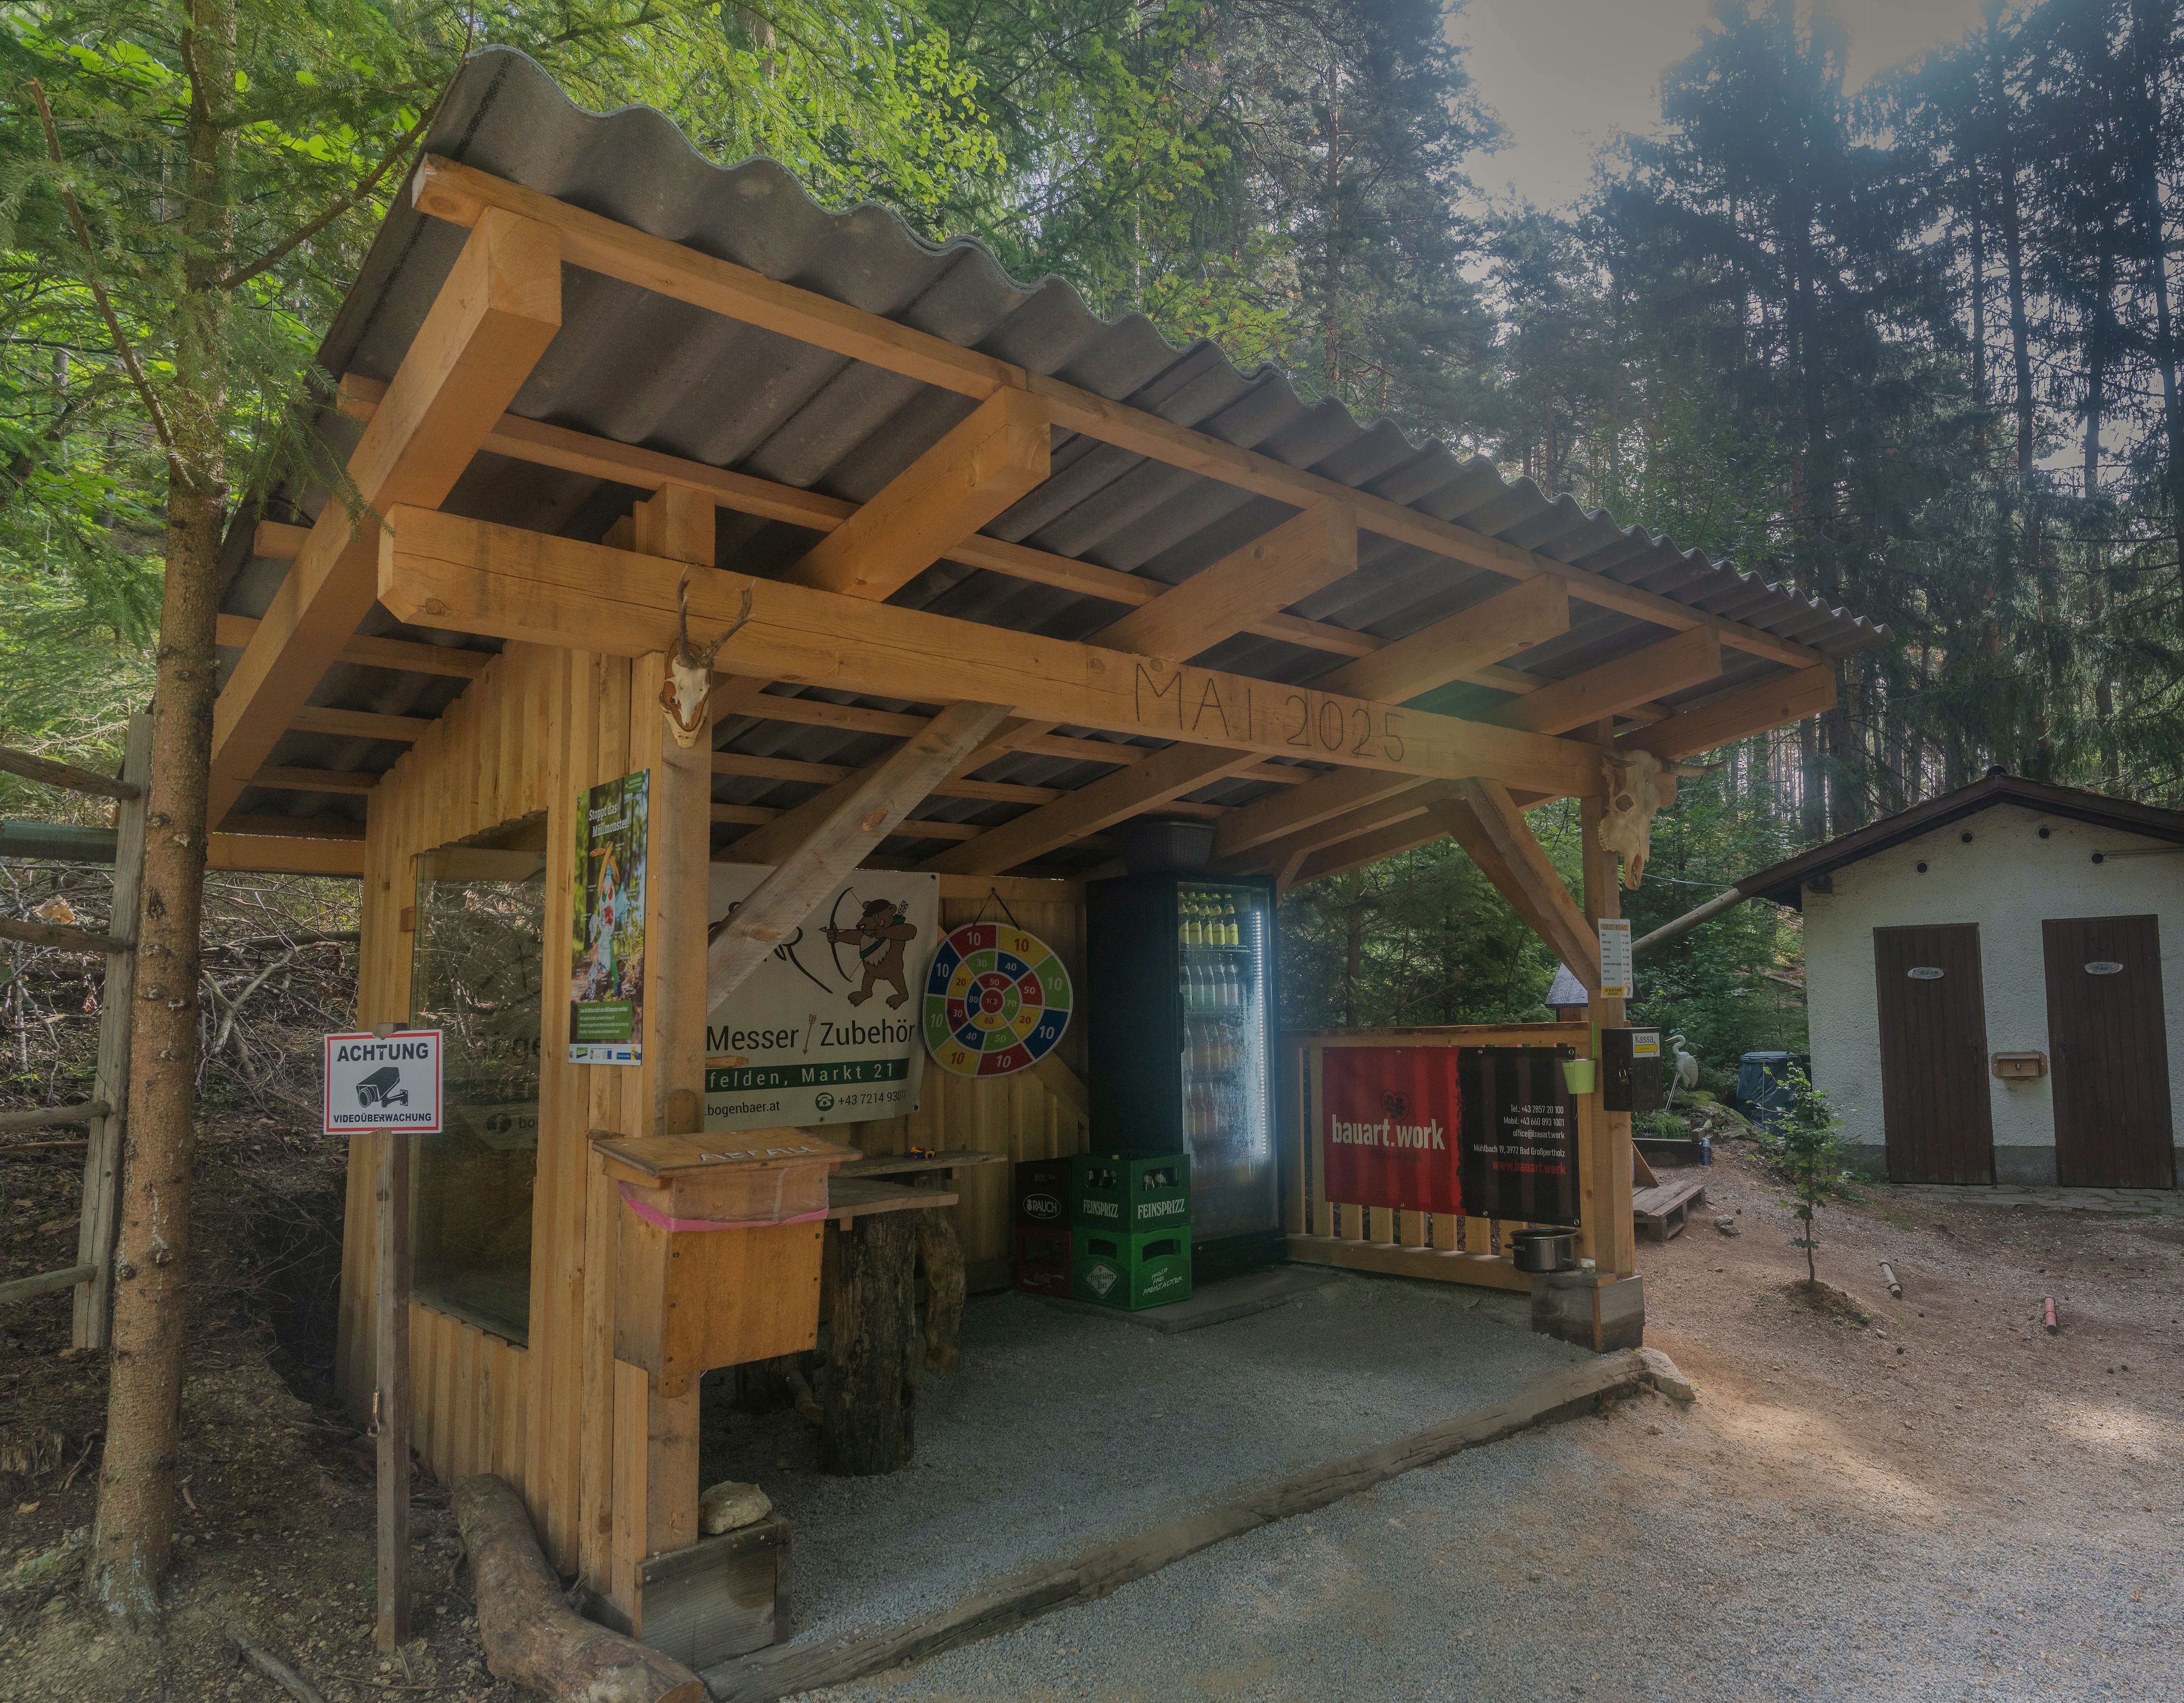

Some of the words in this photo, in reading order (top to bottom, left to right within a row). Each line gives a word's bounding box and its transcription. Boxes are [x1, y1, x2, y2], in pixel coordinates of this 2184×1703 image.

[1136, 663, 1252, 740] MAI
[1285, 695, 1404, 762] 2025
[589, 805, 607, 821] Stoppt
[608, 802, 617, 815] das
[592, 818, 629, 838] Müllmonster!
[967, 931, 981, 946] 10
[1014, 938, 1029, 952] 10
[976, 959, 987, 968] 30
[1005, 963, 1017, 971] 40
[936, 963, 949, 978] 10
[956, 978, 966, 986] 20
[990, 978, 999, 986] 90
[1048, 977, 1063, 991] 10
[1024, 986, 1035, 994] 50
[953, 1009, 963, 1018] 30
[1019, 1016, 1031, 1024] 20
[930, 1014, 943, 1027] 10
[707, 1025, 799, 1051] Messer
[820, 1018, 915, 1047] Zubehör
[995, 1034, 1006, 1042] 50
[1039, 1025, 1054, 1040] 10
[1635, 1035, 1653, 1043] Kassa
[337, 1042, 429, 1062] ACHTUNG
[952, 1052, 965, 1064] 10
[996, 1055, 1011, 1068] 10
[802, 1065, 862, 1083] Markt
[874, 1063, 893, 1079] 21
[839, 1094, 857, 1106] +43
[860, 1091, 883, 1105] 7214
[1510, 1104, 1521, 1113] Tel.:
[1521, 1105, 1531, 1113] +43
[1532, 1105, 1545, 1114] 2857
[1547, 1105, 1553, 1114] 20
[1554, 1106, 1564, 1114] 100
[334, 1113, 431, 1123] VIDEOÜBERWACHUNG
[1504, 1117, 1519, 1125] Mobil:
[1520, 1117, 1529, 1125] +43
[1542, 1118, 1551, 1126] 893
[1553, 1118, 1564, 1126] 1001
[1332, 1114, 1445, 1150] bauart.work
[1513, 1129, 1565, 1140] office@bauart.work
[699, 1146, 820, 1161] ABFALL
[1474, 1144, 1498, 1153] Mühlbach
[1507, 1146, 1518, 1154] 3972
[1520, 1146, 1529, 1155] Bad
[1531, 1147, 1565, 1158] Großpertholz
[1492, 1160, 1566, 1176] www.bauart.work
[1032, 1200, 1057, 1214] RAUCH
[1083, 1199, 1119, 1218] FEINSPRIZZ
[1138, 1198, 1185, 1219] FEINSPRIZZ
[1090, 1272, 1114, 1283] Freistädter
[1152, 1267, 1168, 1280] FRISCH
[1153, 1275, 1164, 1285] FREI
[1097, 1280, 1107, 1289] Bier
